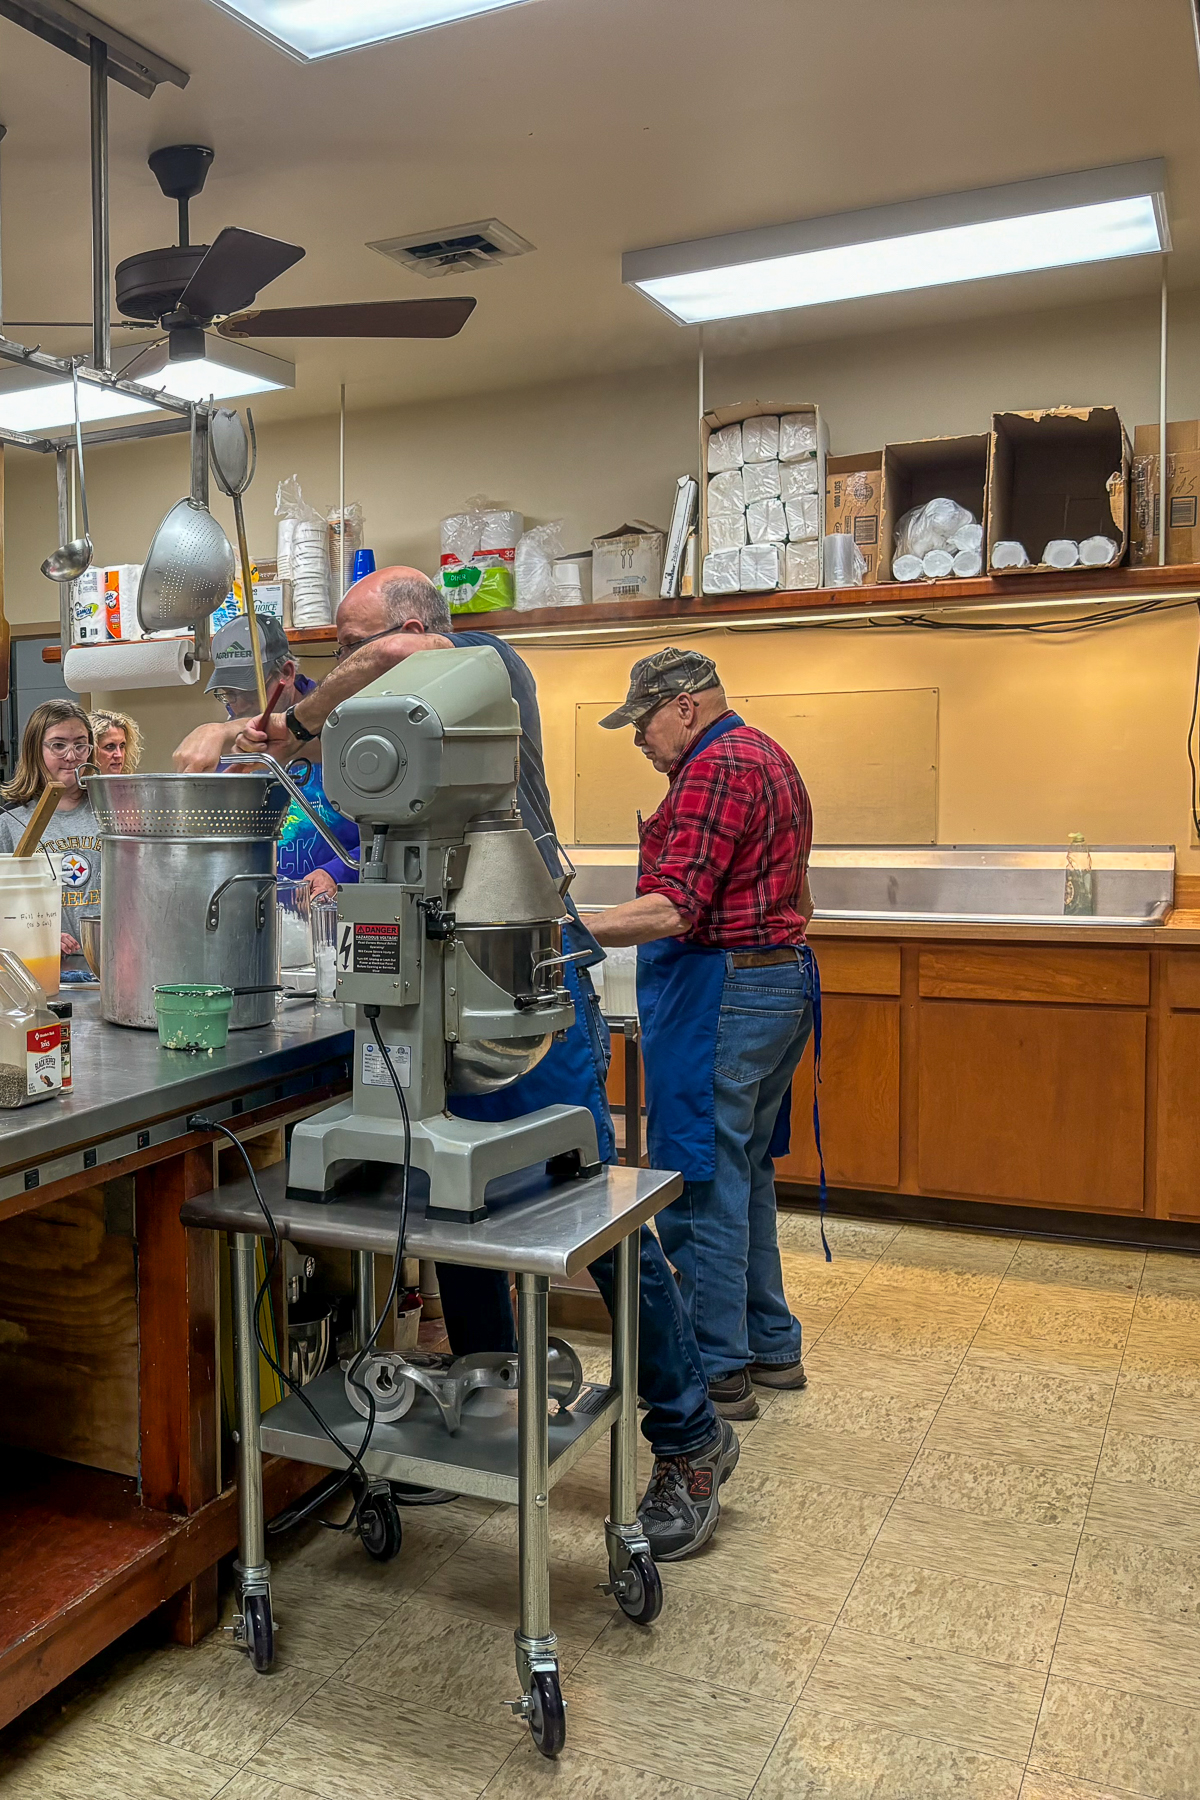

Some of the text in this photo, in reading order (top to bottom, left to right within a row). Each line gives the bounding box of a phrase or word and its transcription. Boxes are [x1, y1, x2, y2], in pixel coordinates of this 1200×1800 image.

[504, 550, 514, 558] 32
[216, 650, 252, 660] AGRITEER
[20, 912, 33, 920] Fill
[365, 926, 397, 934] DANGER
[34, 1060, 45, 1070] BLACK
[46, 1058, 56, 1066] PEPPER
